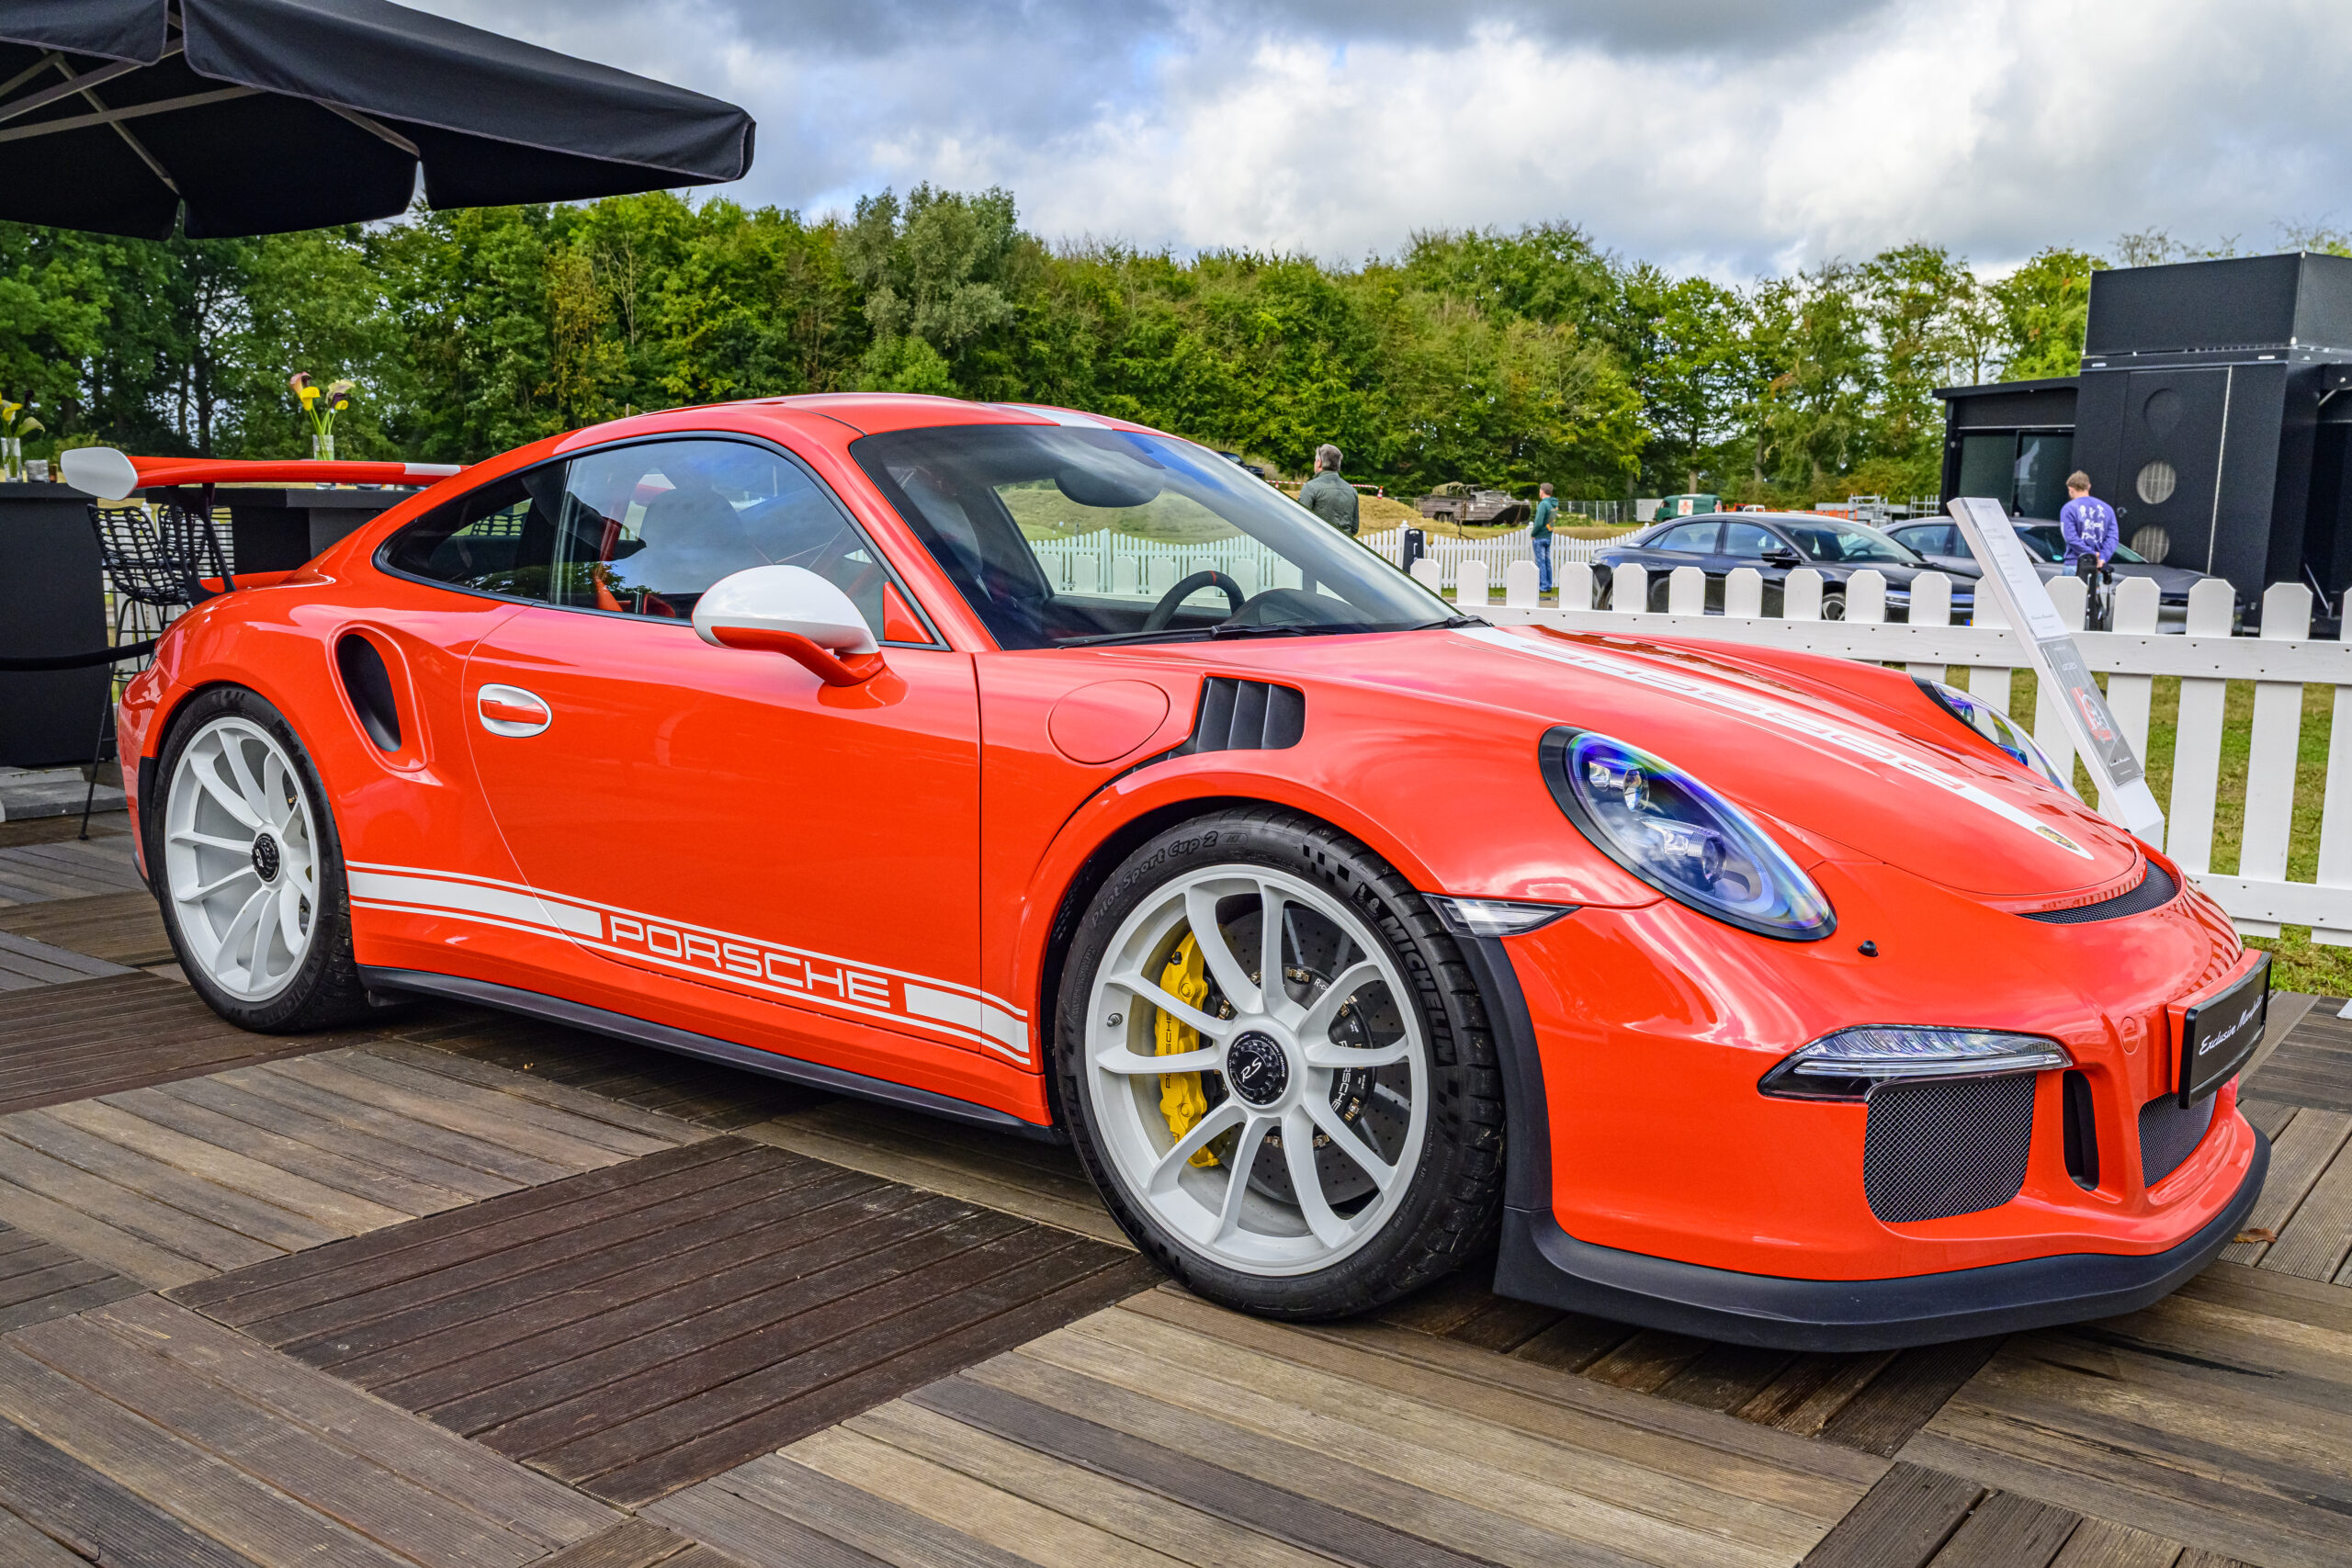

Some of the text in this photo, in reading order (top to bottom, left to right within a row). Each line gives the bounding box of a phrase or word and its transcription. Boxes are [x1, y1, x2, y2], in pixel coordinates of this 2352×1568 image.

[1091, 830, 1218, 928] Pilot Sport Cup 2
[608, 914, 891, 1009] PORSCHE
[1380, 916, 1456, 1066] MICHELIN
[1240, 1057, 1262, 1083] RS
